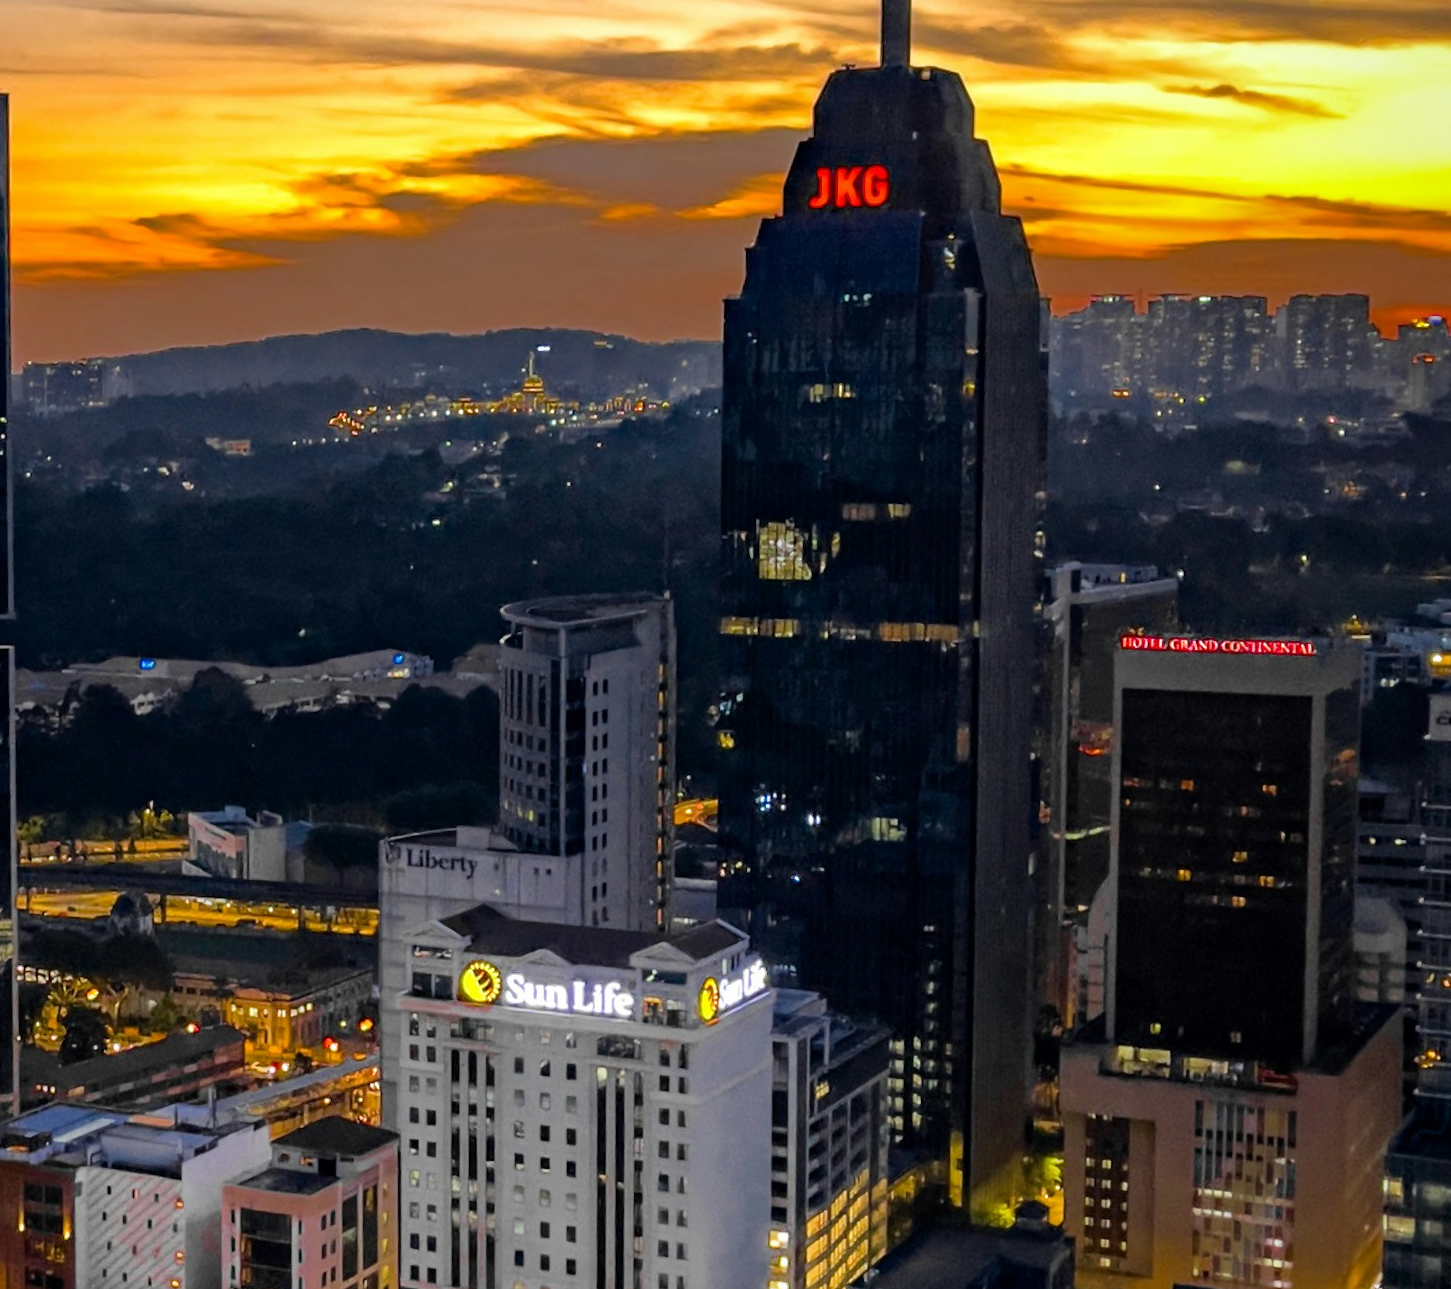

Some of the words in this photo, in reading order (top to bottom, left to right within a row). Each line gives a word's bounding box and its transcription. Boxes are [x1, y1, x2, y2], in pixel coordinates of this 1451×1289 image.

[808, 163, 890, 209] JKG
[1121, 636, 1168, 650] HOTEL
[1169, 637, 1219, 652] GRAND
[1220, 639, 1318, 656] CONTINENTAL
[406, 848, 479, 880] Liberty
[505, 973, 569, 1011] Sun
[572, 980, 635, 1017] Life
